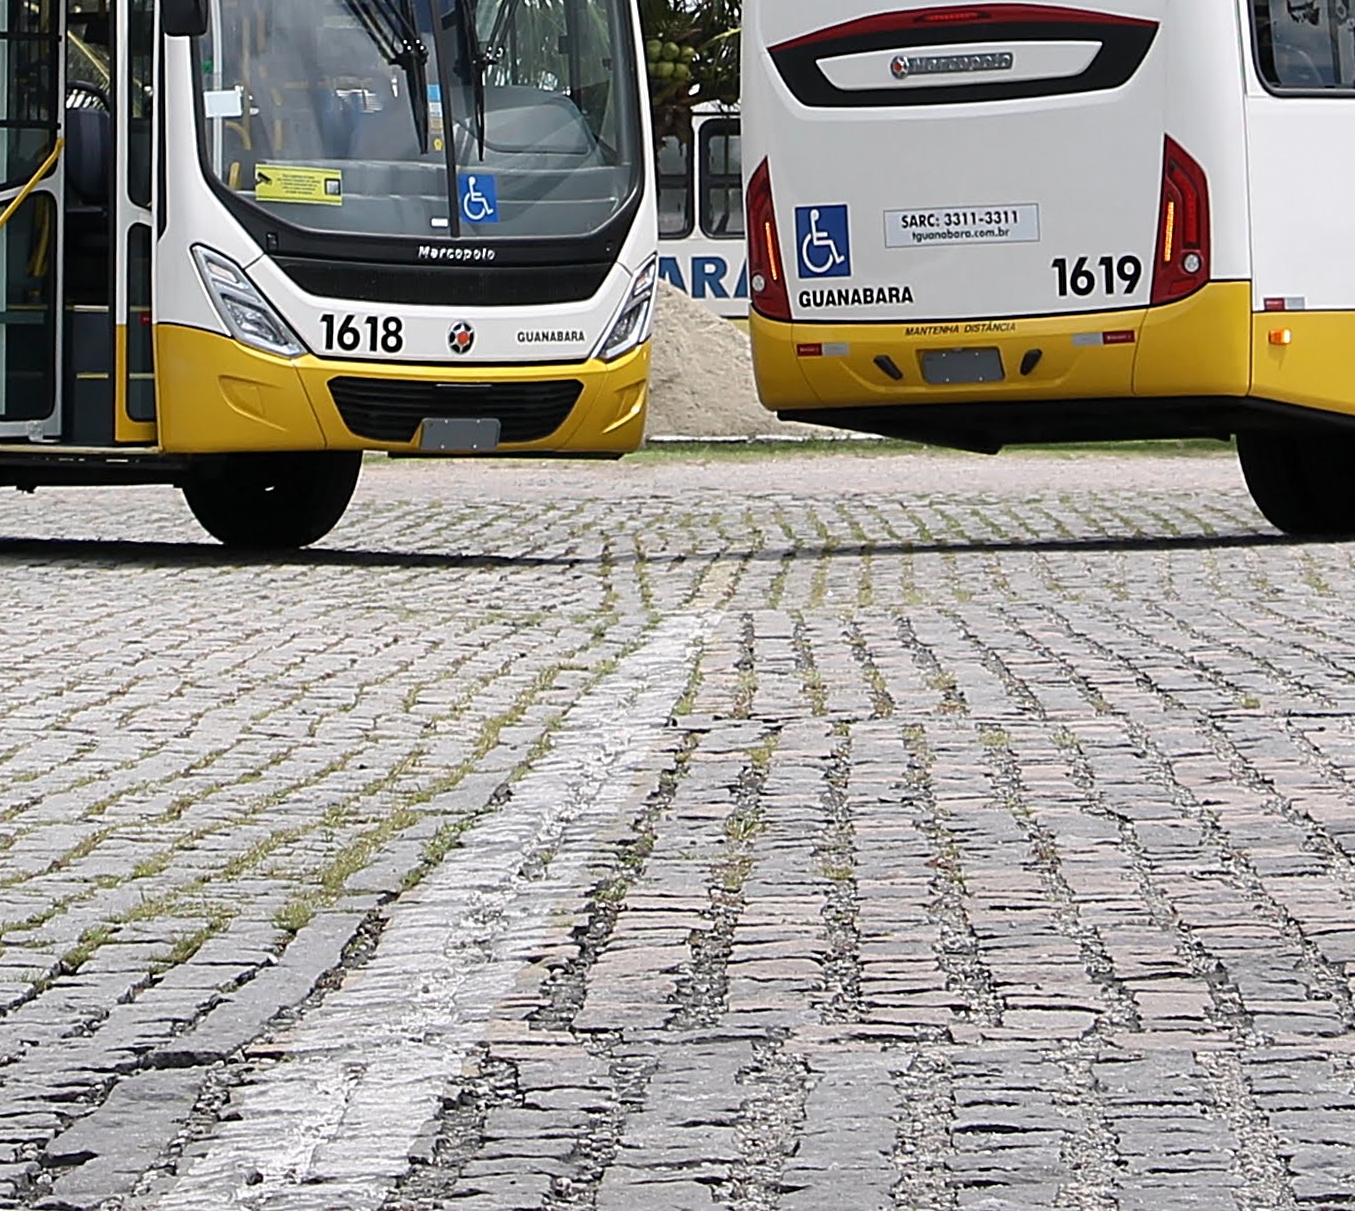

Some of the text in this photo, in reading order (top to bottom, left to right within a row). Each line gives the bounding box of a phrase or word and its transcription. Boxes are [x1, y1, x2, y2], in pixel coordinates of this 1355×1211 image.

[901, 210, 1018, 228] SARC: 3311-3311
[912, 226, 1009, 242] tguanabara.com.br
[418, 246, 496, 262] Marcopolo
[1051, 255, 1143, 297] 1619
[798, 286, 914, 309] GUANABARA
[320, 313, 403, 353] 1618
[517, 330, 585, 343] GUANABARA
[905, 321, 1016, 336] MANTENHA DISTÂNCIA
